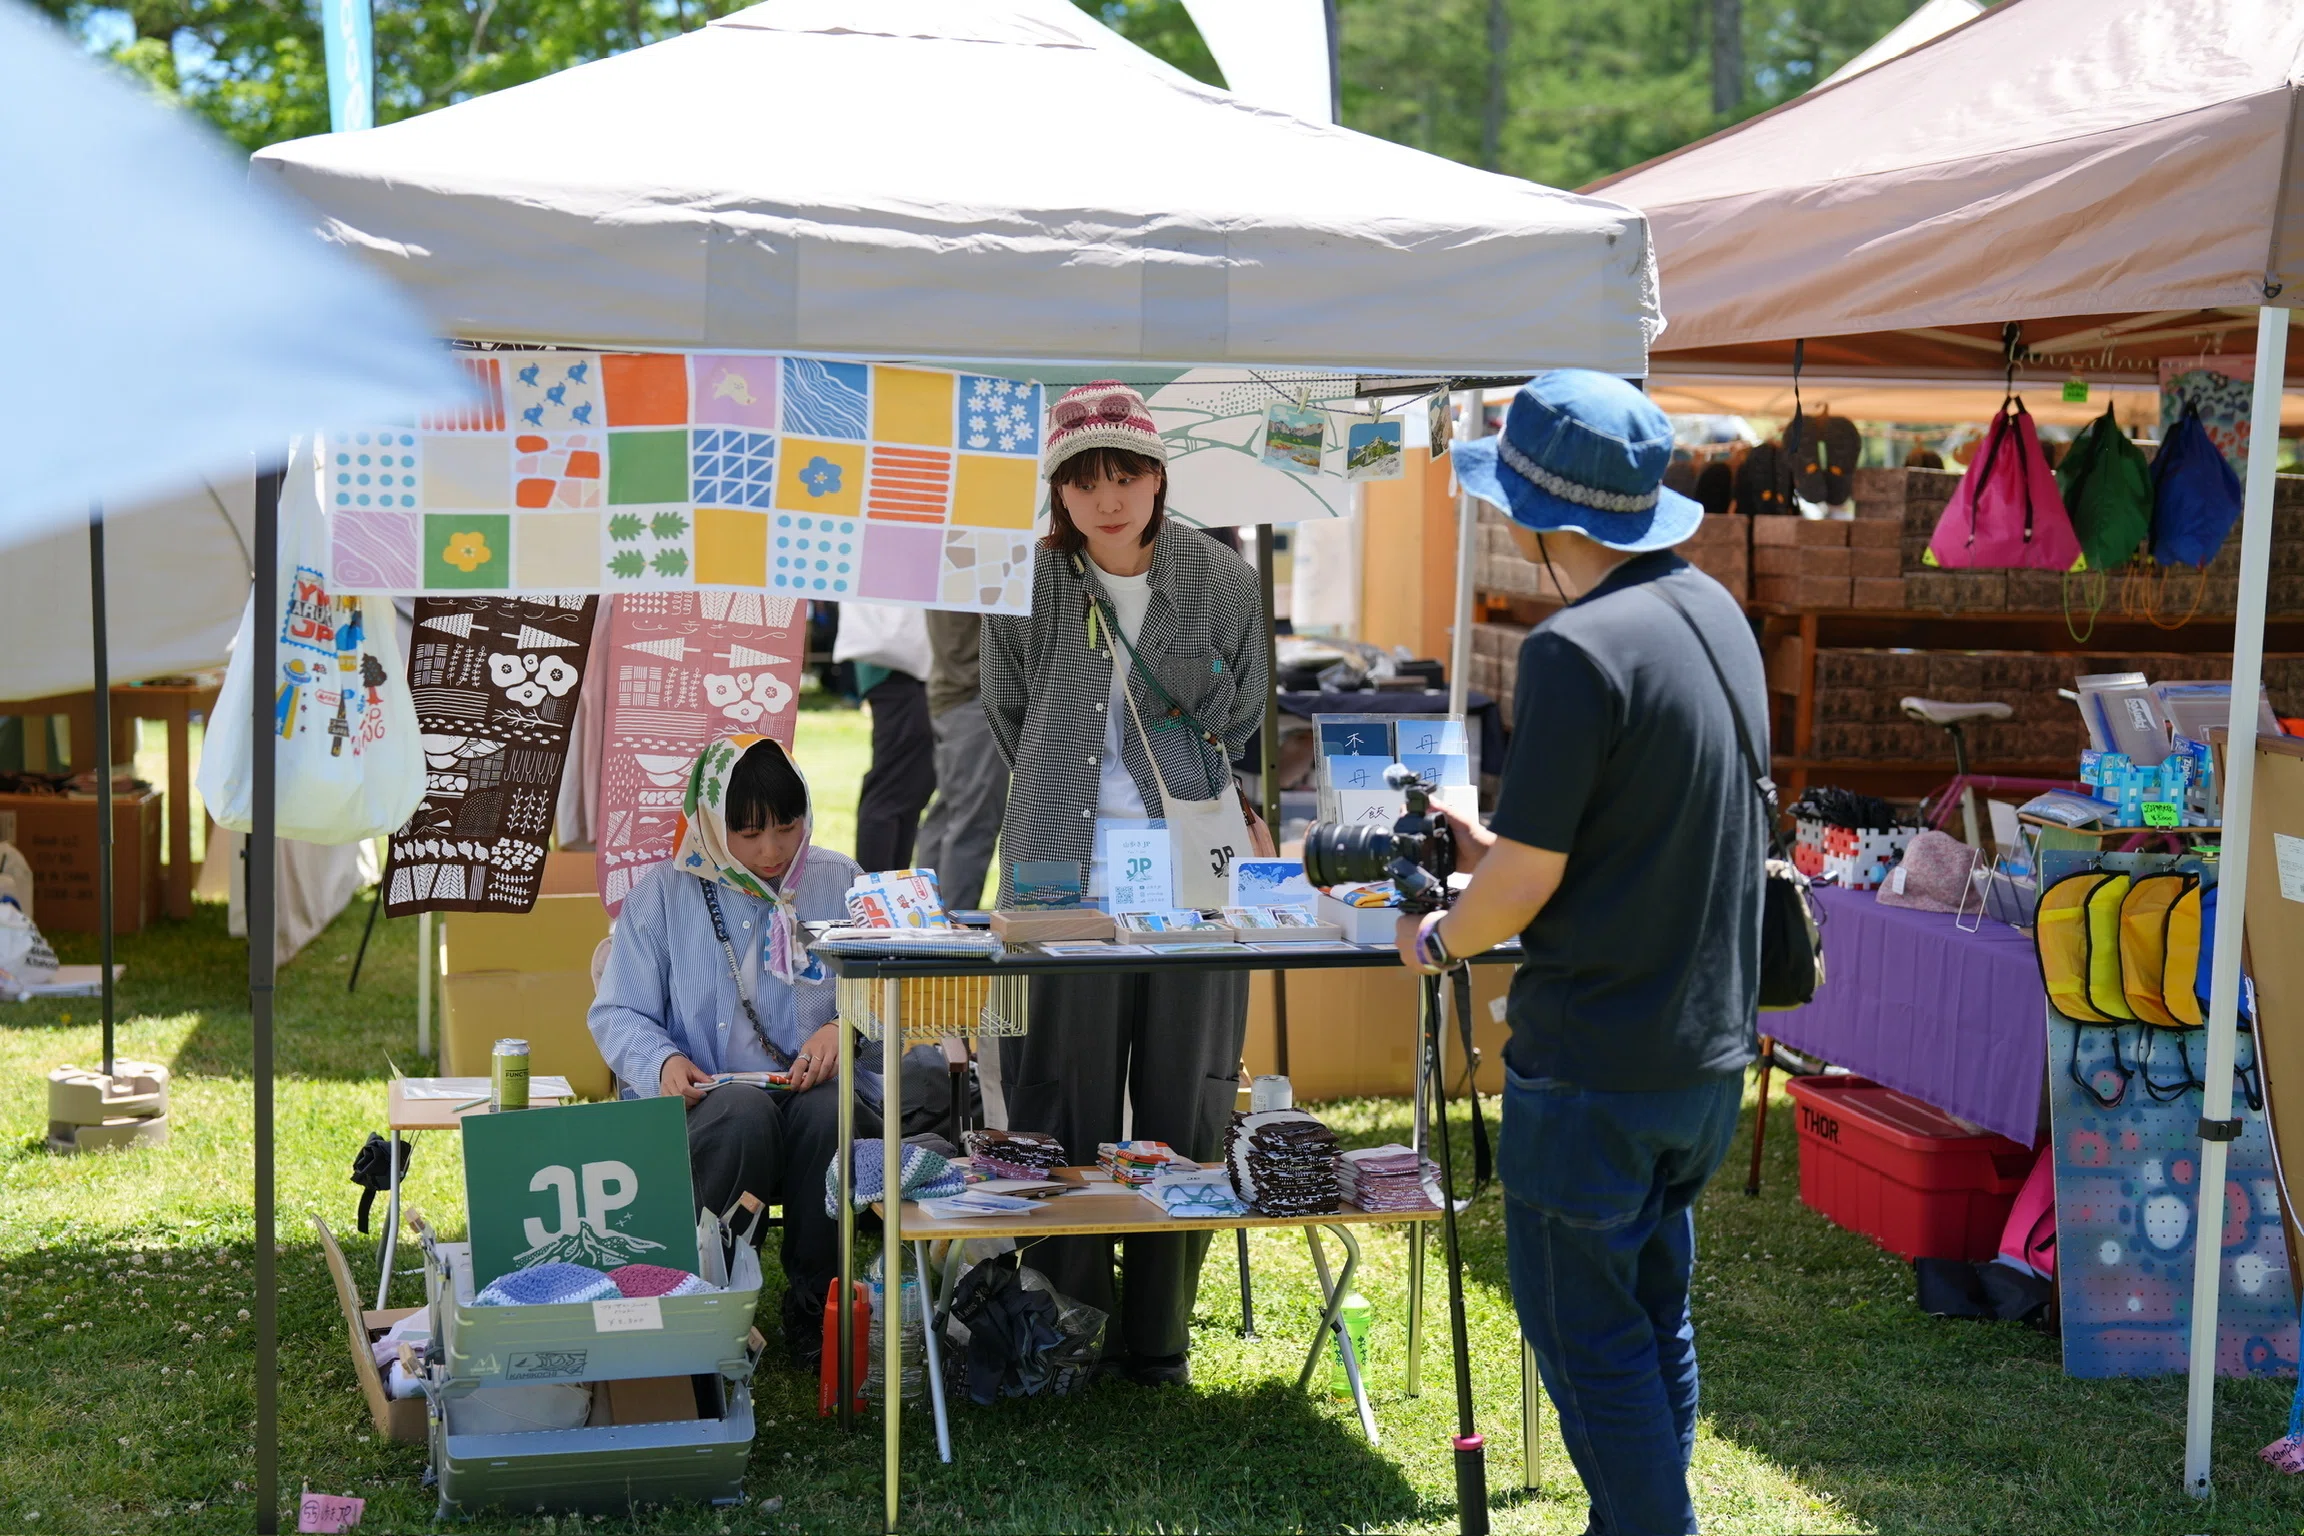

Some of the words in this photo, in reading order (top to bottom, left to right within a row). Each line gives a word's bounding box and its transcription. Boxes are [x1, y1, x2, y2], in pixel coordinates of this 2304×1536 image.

[290, 618, 334, 642] JP
[1126, 857, 1152, 878] JP
[1210, 845, 1235, 874] JP
[1802, 1106, 1840, 1144] THOR
[522, 1160, 638, 1248] JP
[509, 1369, 558, 1380] KAMIKOCHI
